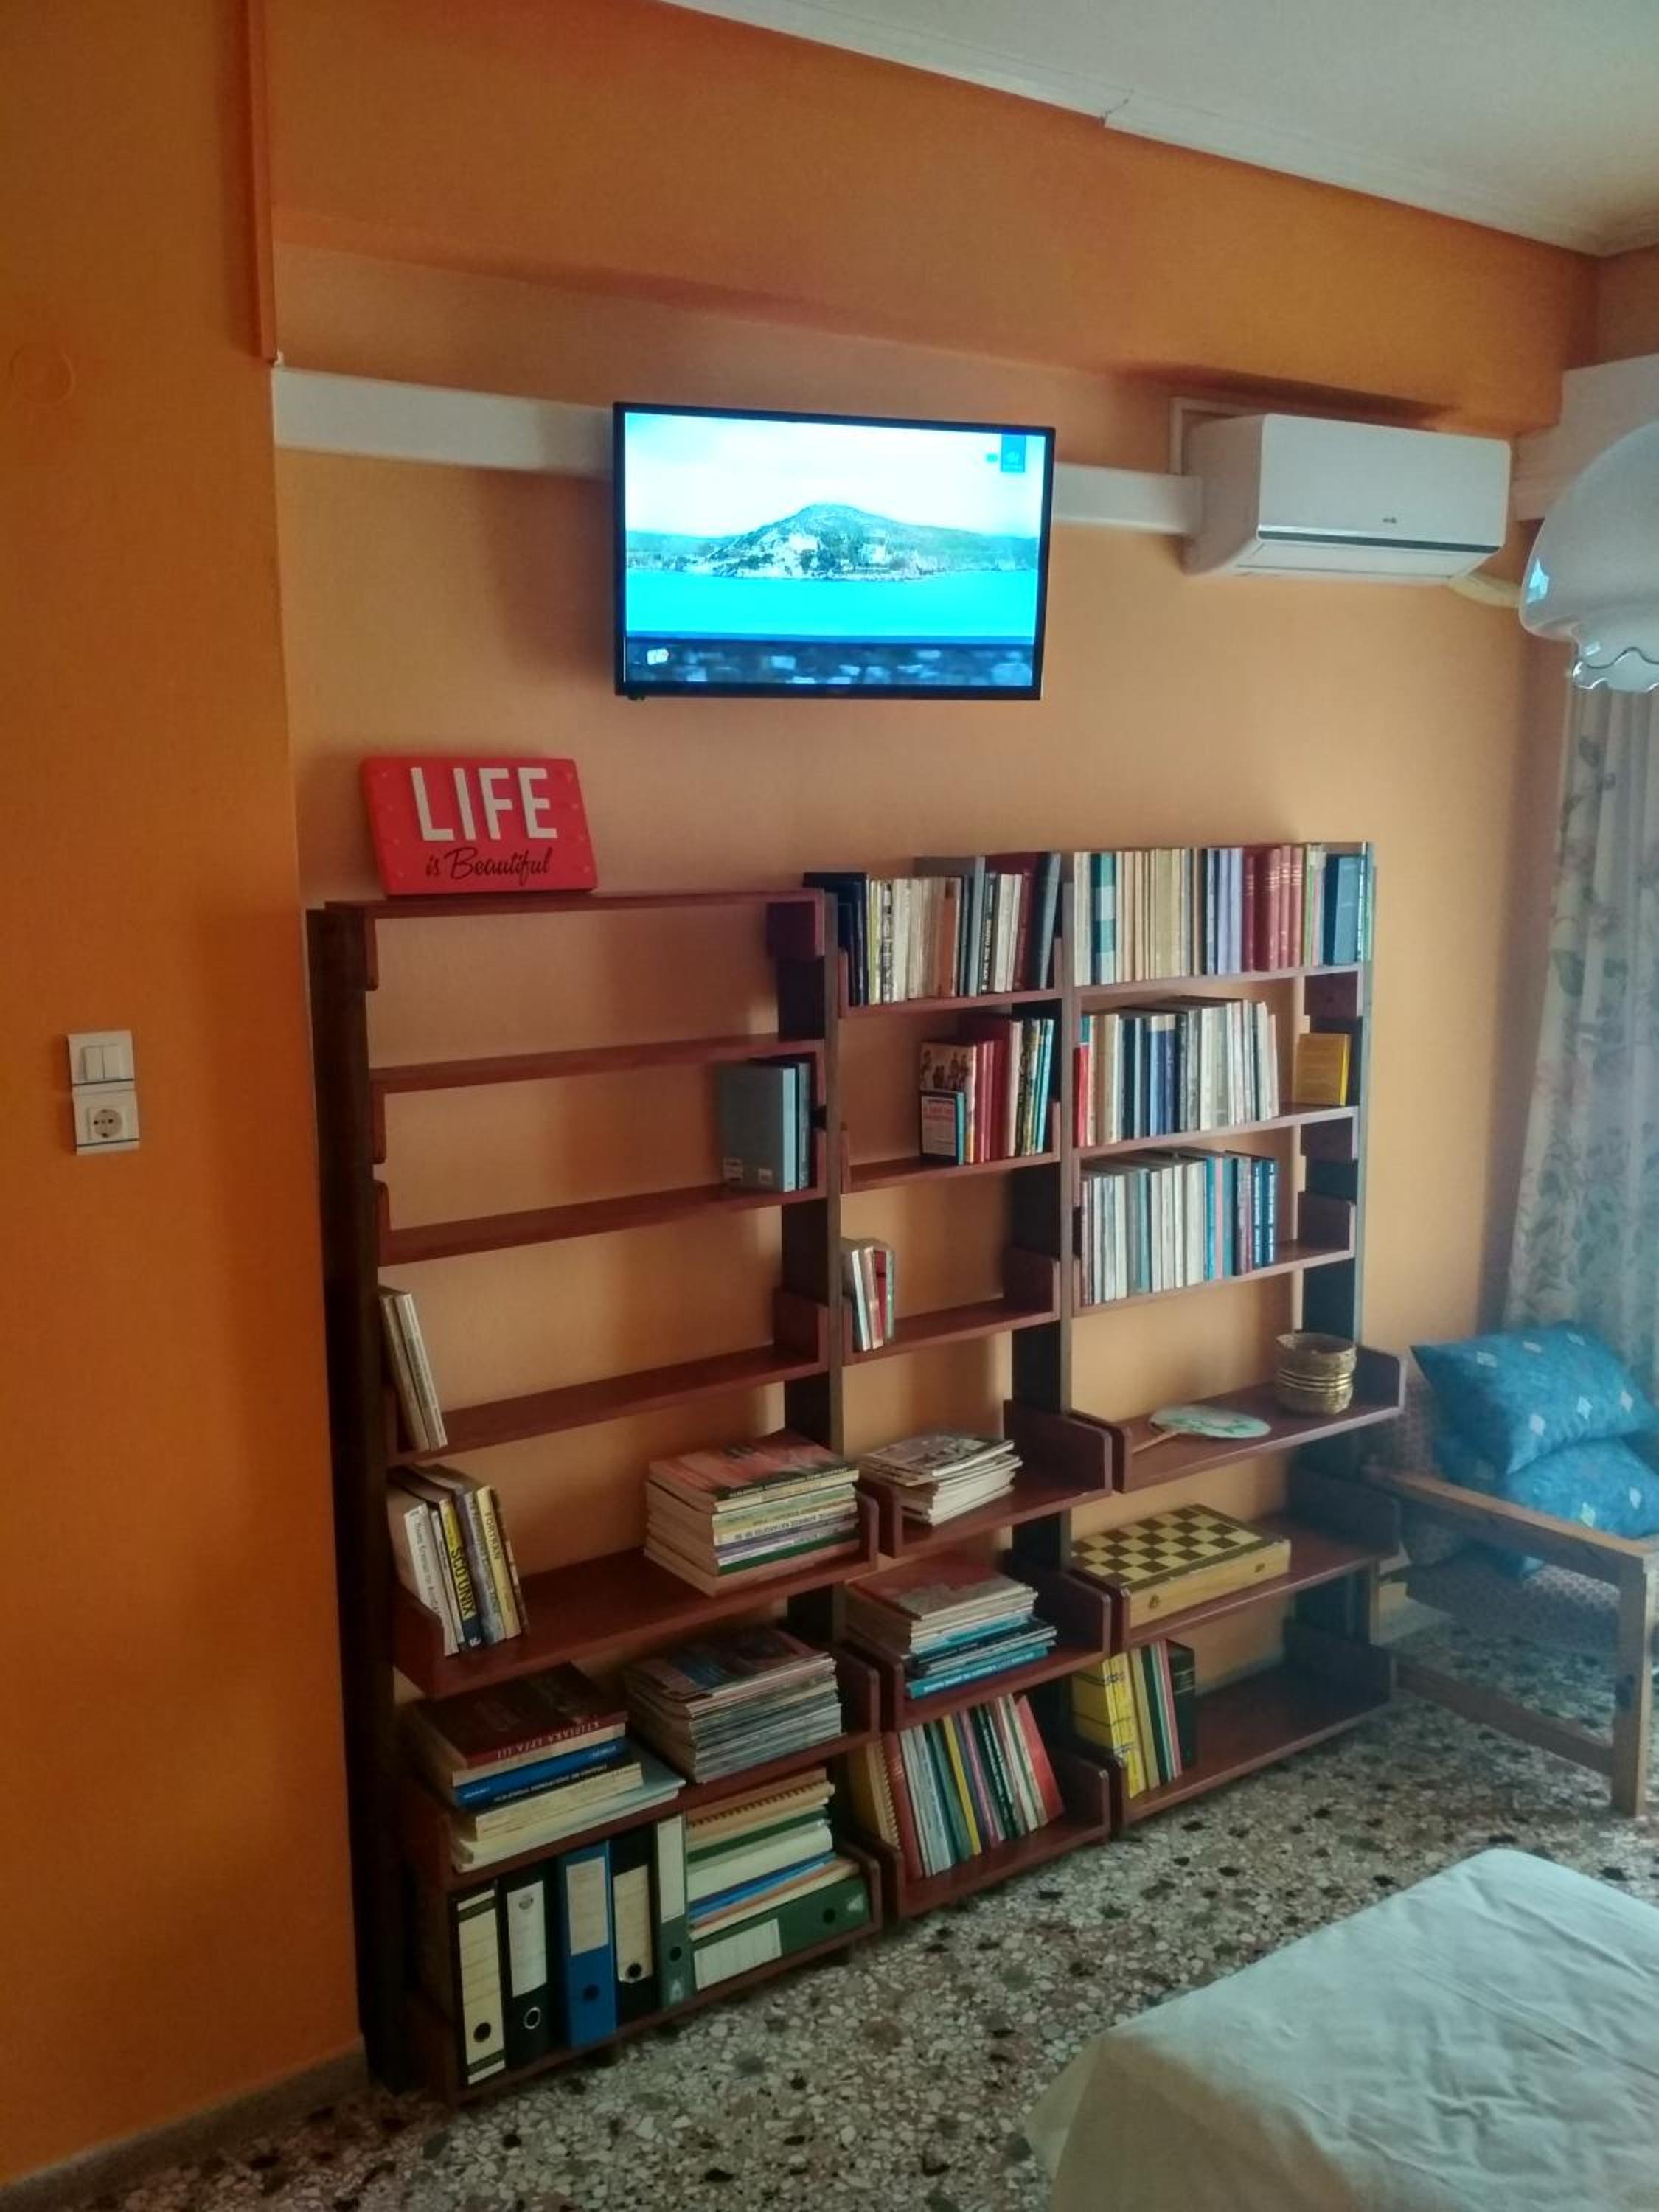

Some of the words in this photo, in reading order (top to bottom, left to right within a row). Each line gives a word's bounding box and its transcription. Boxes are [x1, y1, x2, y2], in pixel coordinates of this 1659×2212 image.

[410, 767, 557, 841] LIFE
[425, 858, 439, 877] is
[442, 846, 553, 886] Beautiful
[484, 1512, 502, 1560] FORTRAN
[451, 1545, 467, 1579] SCO
[458, 1579, 476, 1617] UNIX
